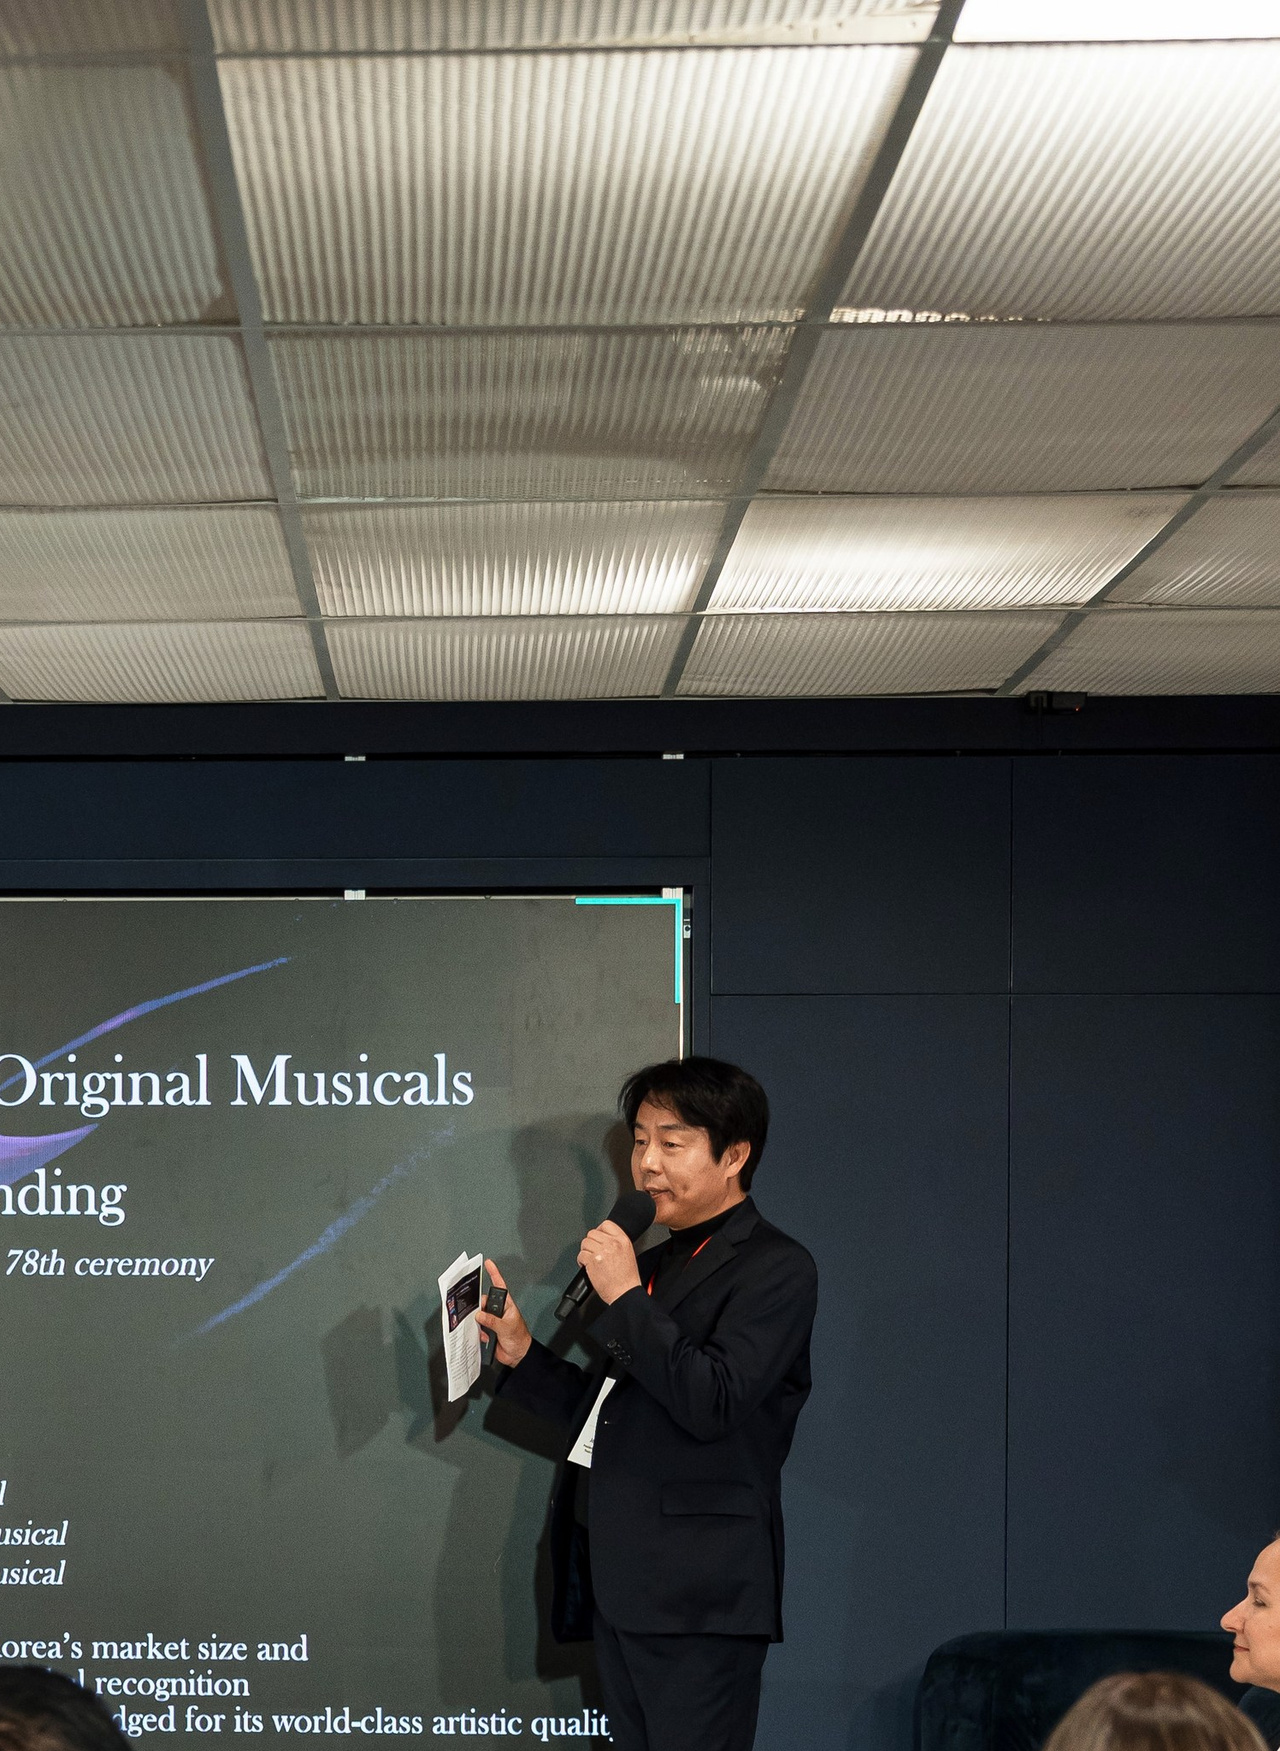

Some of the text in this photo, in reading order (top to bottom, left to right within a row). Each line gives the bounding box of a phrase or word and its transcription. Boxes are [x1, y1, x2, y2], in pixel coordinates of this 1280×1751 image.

[230, 1052, 477, 1106] Musicals
[5, 1248, 66, 1276] 78th
[74, 1257, 216, 1282] ceremony
[91, 1632, 191, 1661] market
[197, 1633, 248, 1661] size
[256, 1633, 309, 1662] and
[94, 1668, 251, 1700] recognition
[185, 1704, 226, 1733] for
[233, 1705, 264, 1733] its
[271, 1706, 423, 1735] world-class
[432, 1707, 523, 1736] artistic
[530, 1708, 614, 1743] qualit
